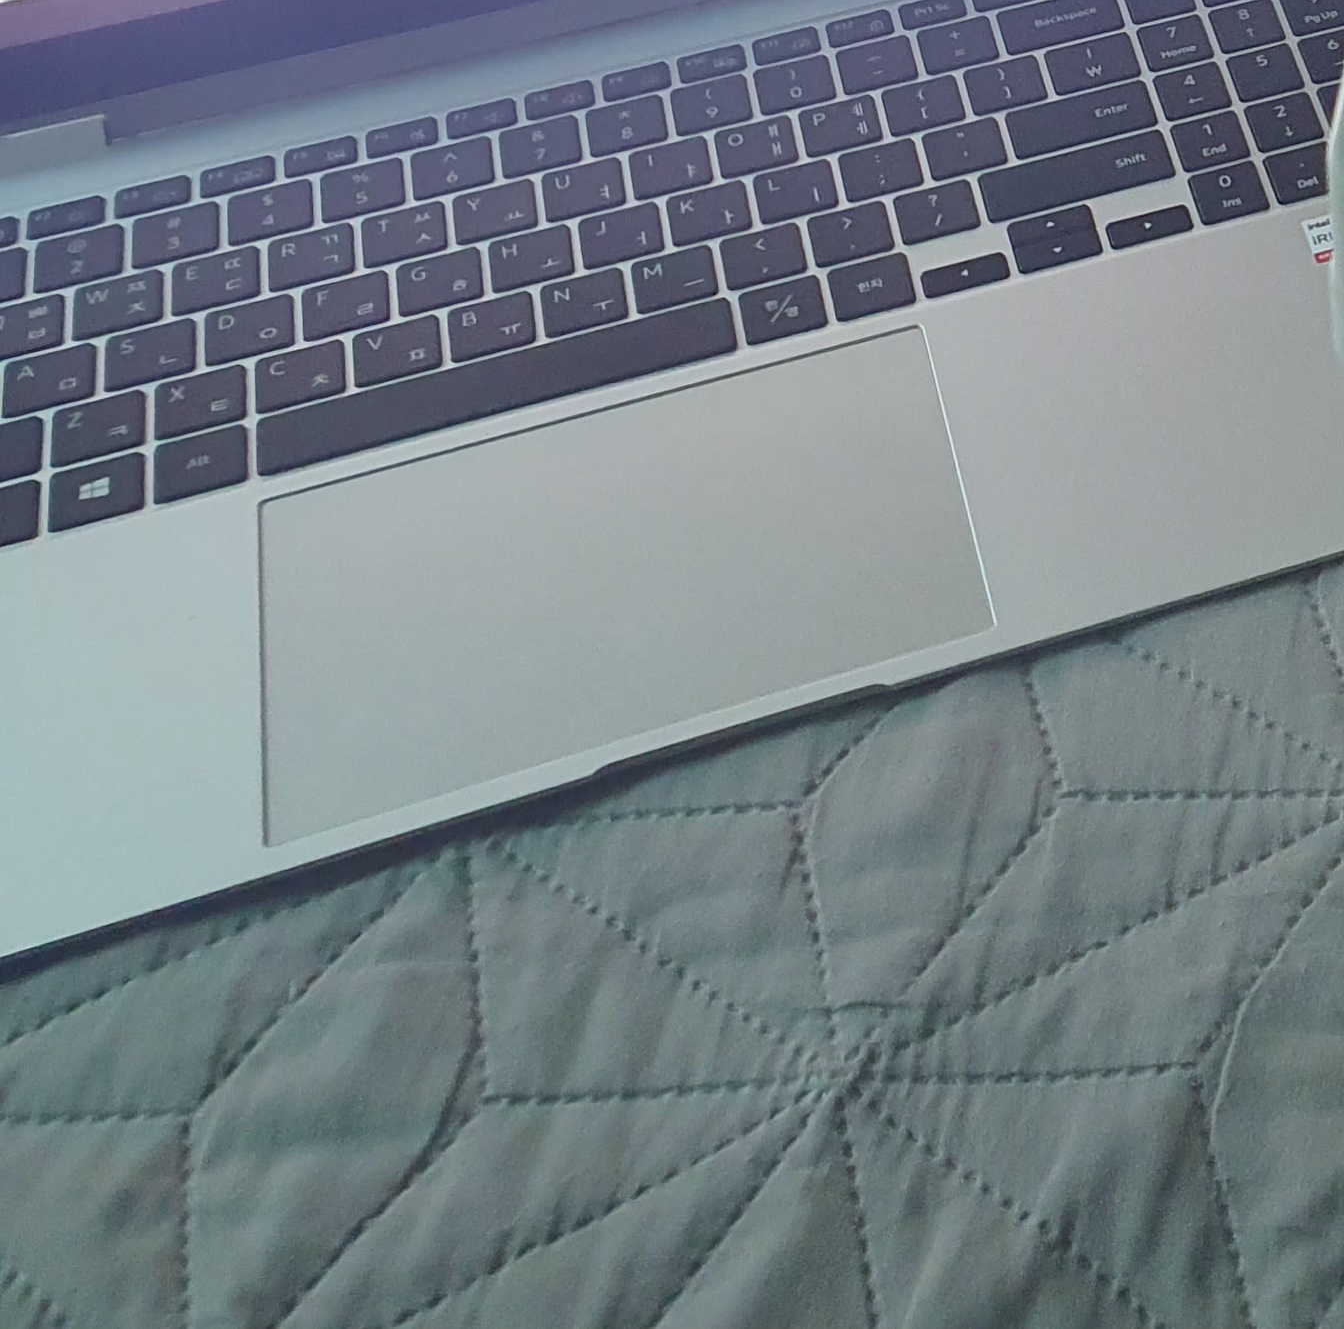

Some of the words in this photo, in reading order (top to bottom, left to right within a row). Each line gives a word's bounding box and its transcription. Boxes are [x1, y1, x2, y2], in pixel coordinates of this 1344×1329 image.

[1033, 5, 1099, 29] Backspace
[1237, 8, 1250, 21] 8
[1166, 25, 1178, 40] 7
[1159, 43, 1197, 59] Home
[1327, 37, 1340, 51] 6
[1256, 54, 1269, 68] 5
[1183, 74, 1196, 87] 4
[1093, 100, 1130, 119] Enter
[1273, 105, 1288, 119] 2
[812, 111, 827, 128] P
[1201, 143, 1228, 158] End
[1114, 151, 1148, 170] Shift
[554, 175, 572, 191] U
[766, 177, 782, 194] L
[466, 197, 481, 213] Y
[679, 198, 697, 215] K
[281, 242, 297, 259] R
[501, 242, 519, 261] H
[410, 266, 427, 283] G
[642, 262, 664, 281] M
[85, 287, 110, 306] W
[315, 289, 330, 308] F
[552, 286, 572, 304] N
[217, 314, 235, 331] D
[461, 310, 478, 328] B
[119, 339, 137, 357] S
[365, 333, 385, 352] V
[16, 364, 36, 382] A
[268, 360, 288, 378] C
[167, 384, 187, 404] X
[66, 411, 85, 431] Z
